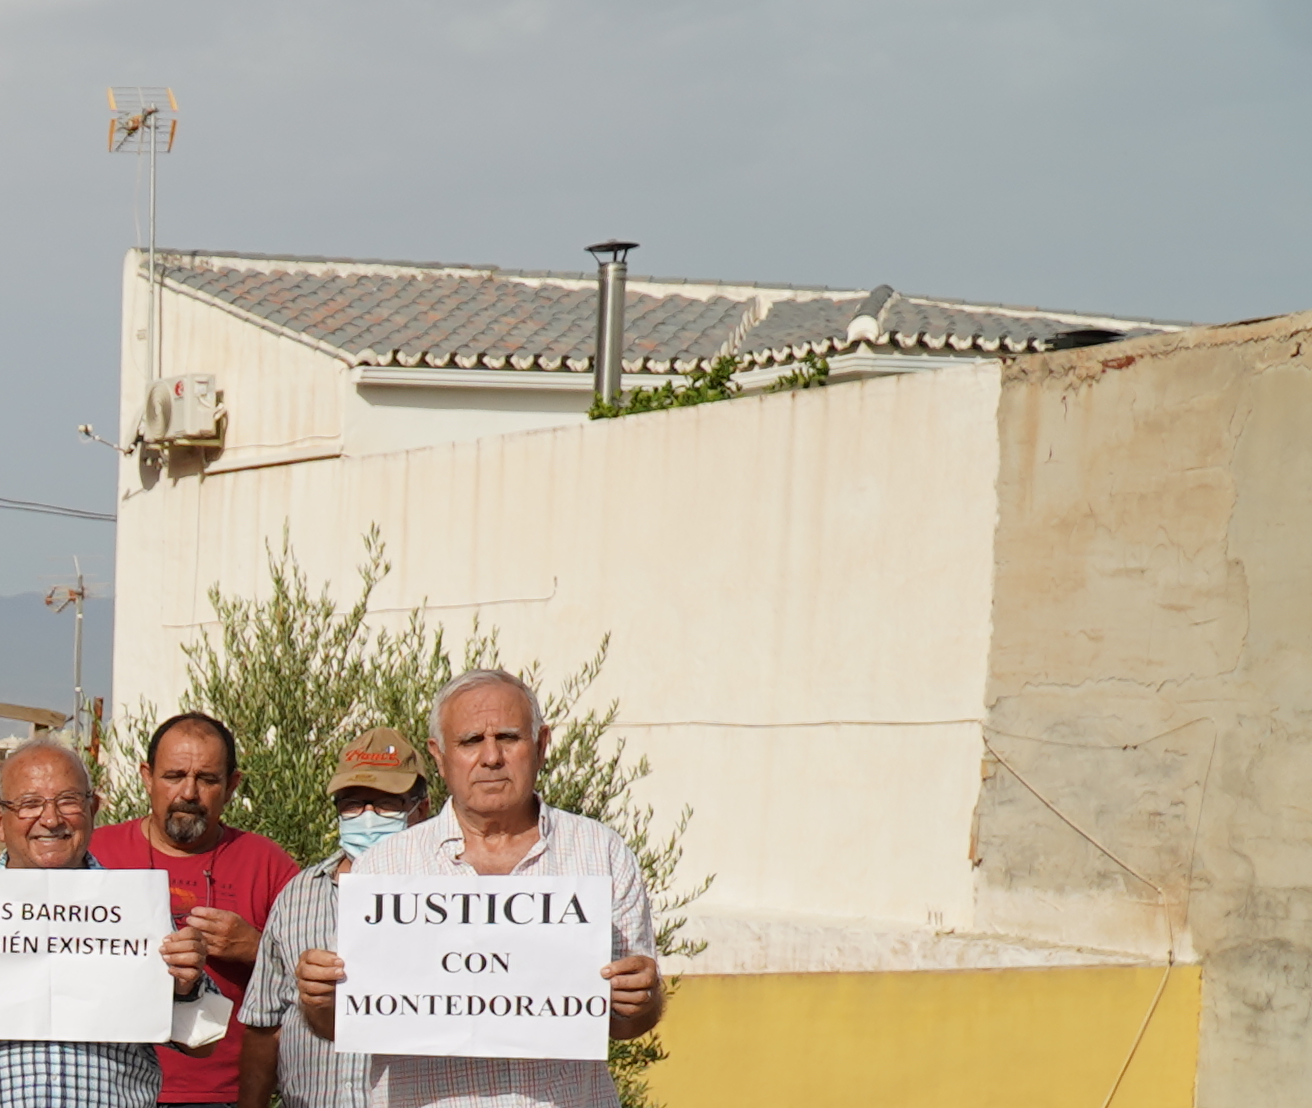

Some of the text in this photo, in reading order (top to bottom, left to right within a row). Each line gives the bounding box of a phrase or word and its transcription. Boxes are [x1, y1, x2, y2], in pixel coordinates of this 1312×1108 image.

[21, 903, 122, 924] BARRIOS
[364, 892, 590, 925] JUSTICIA
[47, 936, 148, 957] EXISTEN!
[441, 952, 510, 974] CON
[346, 994, 607, 1018] MONTEDORADO
